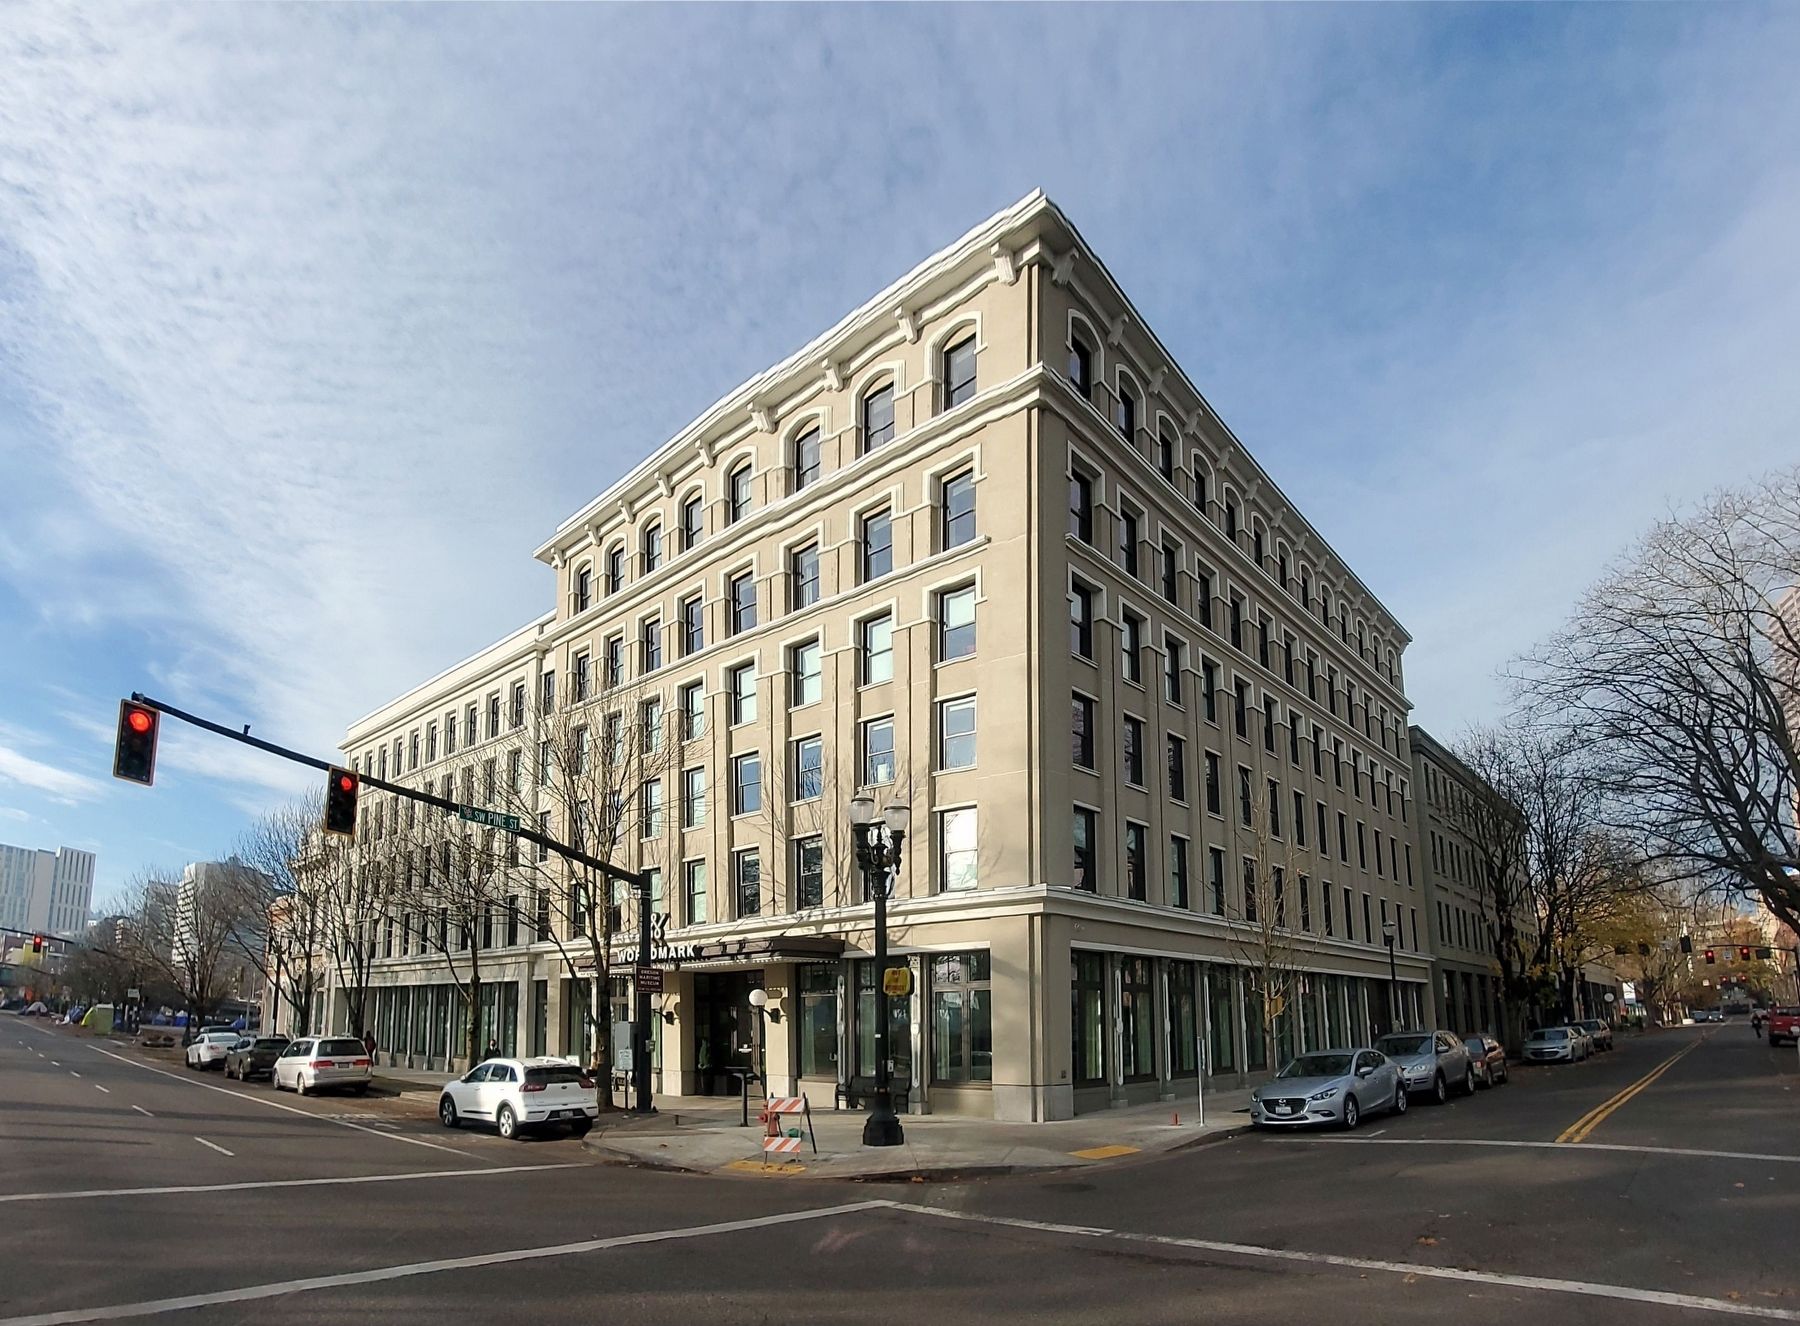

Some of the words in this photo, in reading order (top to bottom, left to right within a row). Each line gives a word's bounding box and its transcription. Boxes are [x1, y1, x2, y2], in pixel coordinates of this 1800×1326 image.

[474, 811, 486, 823] SW
[488, 813, 507, 828] PINE
[509, 819, 518, 830] ST
[617, 945, 695, 963] WORDMARK
